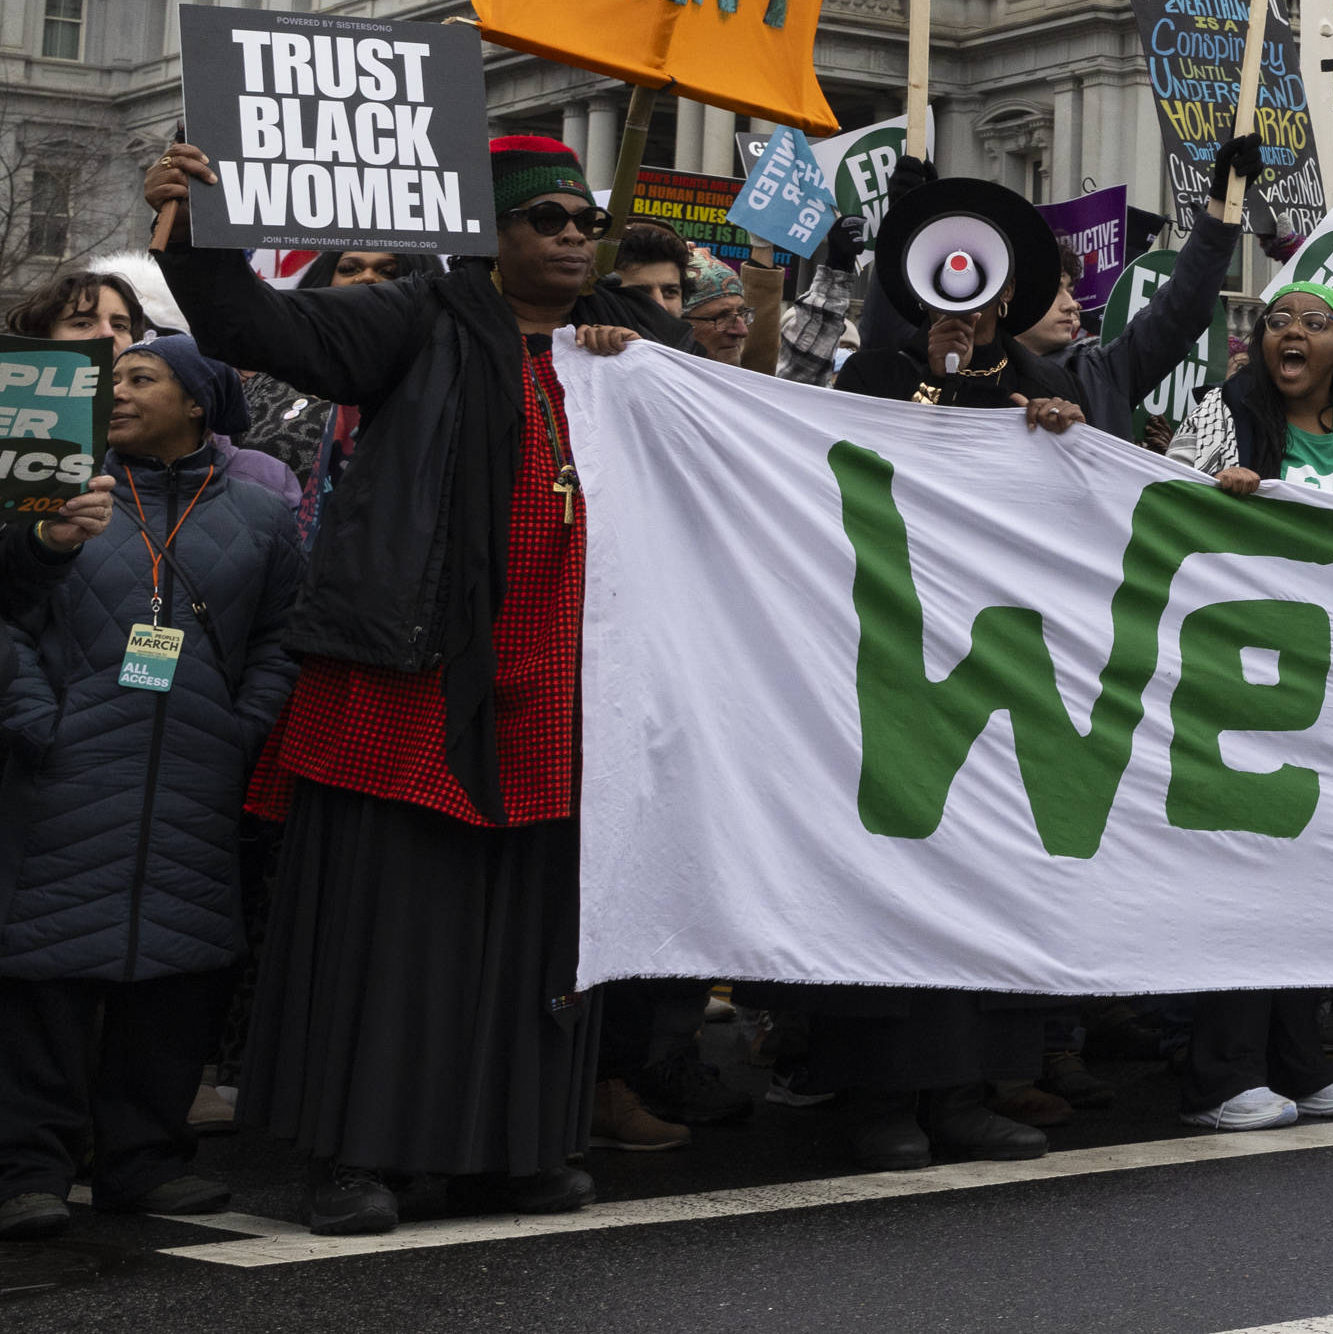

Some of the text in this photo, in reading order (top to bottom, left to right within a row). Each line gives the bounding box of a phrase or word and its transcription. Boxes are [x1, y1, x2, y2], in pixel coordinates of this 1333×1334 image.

[277, 16, 392, 33] POWERED BY SISTERSONG
[1195, 16, 1239, 32] IS A
[1152, 18, 1285, 75] Conspircy
[231, 29, 430, 103] TRUST
[1179, 58, 1232, 82] UNTIL
[1150, 57, 1307, 111] UNDERSAND
[238, 95, 439, 167] BLACK
[1160, 100, 1217, 141] HOW
[1246, 108, 1308, 156] ORKS
[845, 139, 907, 203] ER
[218, 160, 481, 233] WOMEN.
[650, 184, 695, 203] HUMAN
[633, 199, 727, 225] BLACK LIVES
[262, 235, 438, 249] JOIN THE MOVEMENT AT SISTERSONG.ORG
[716, 224, 732, 243] IS
[720, 243, 749, 259] OVER
[1097, 244, 1120, 273] ALL
[17, 497, 65, 513] 202
[130, 636, 179, 652] MARCH
[123, 662, 149, 675] ALL
[121, 673, 169, 688] ACCESS
